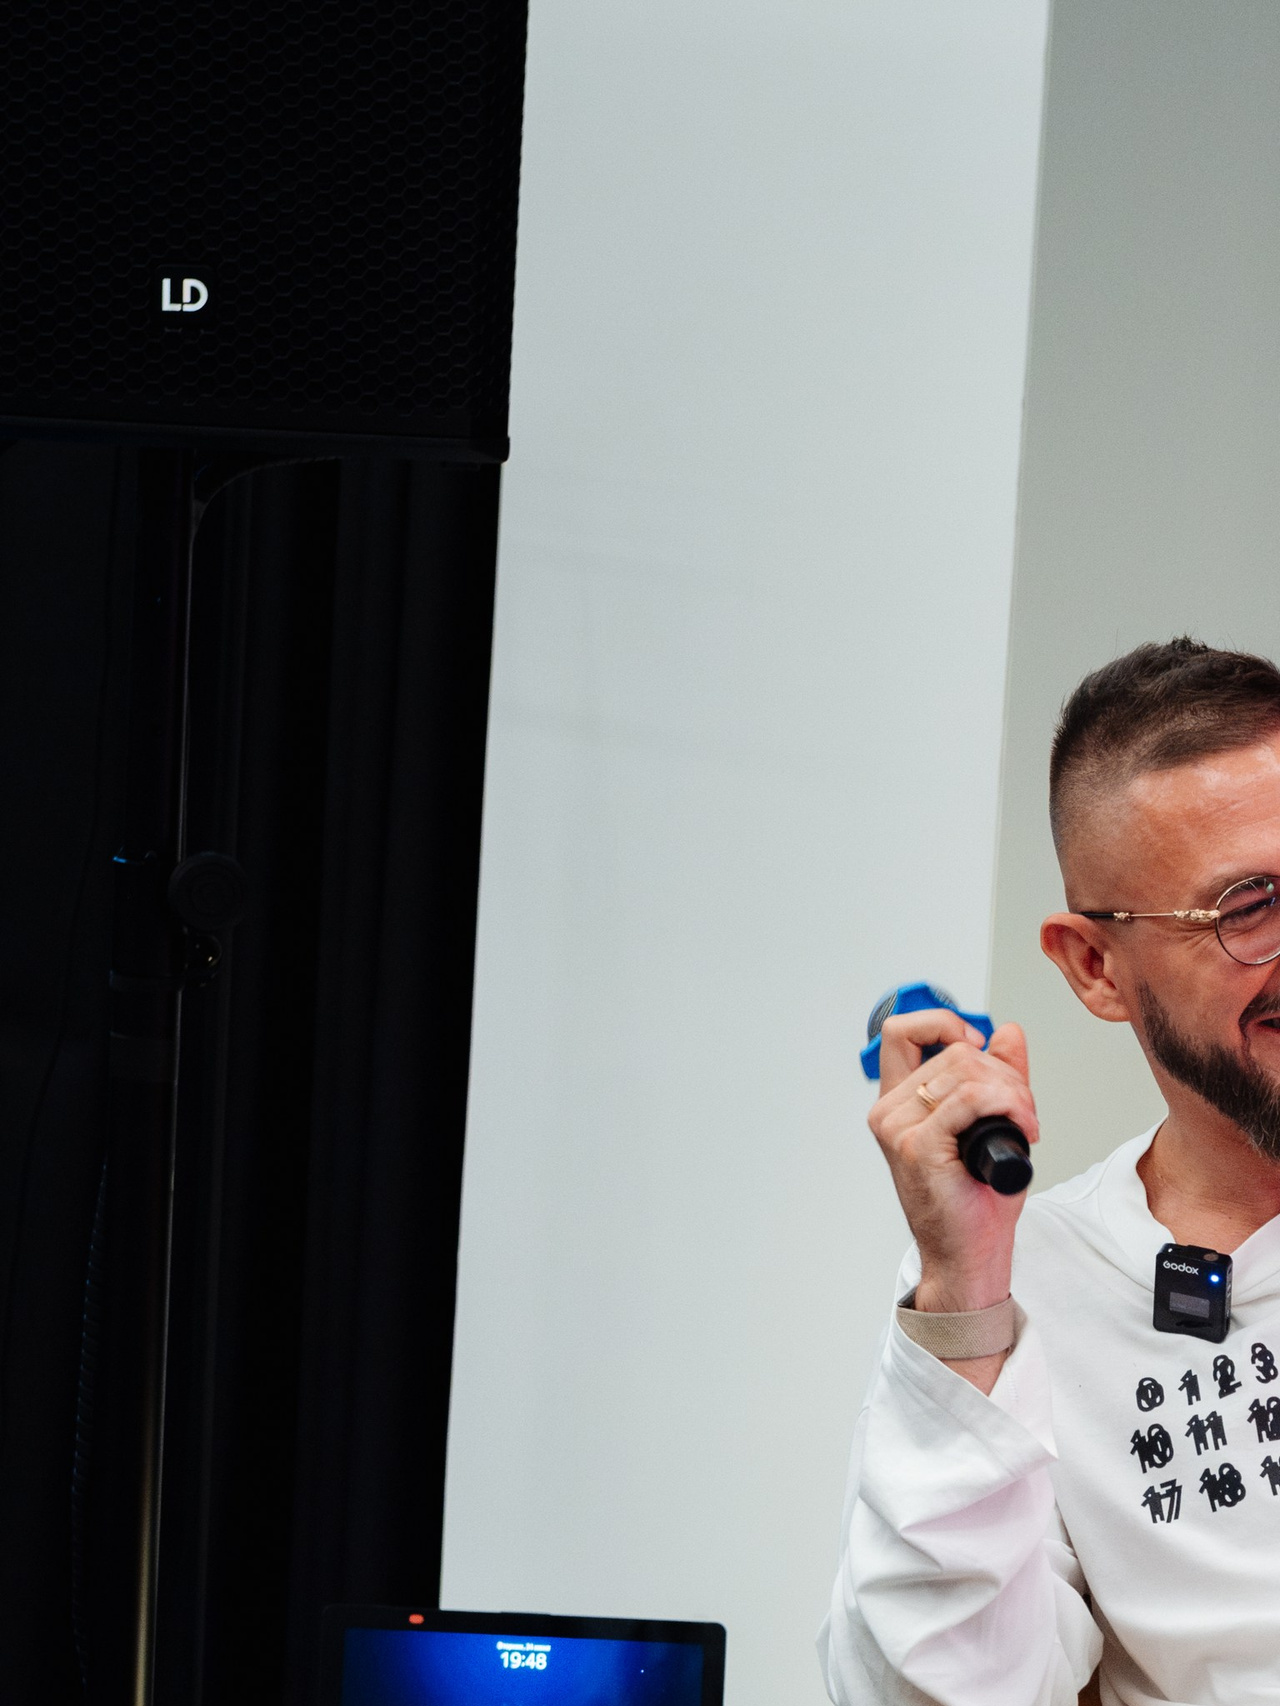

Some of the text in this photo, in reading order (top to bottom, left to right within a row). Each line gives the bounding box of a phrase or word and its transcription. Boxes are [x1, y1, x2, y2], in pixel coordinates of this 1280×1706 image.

[162, 278, 208, 312] LD
[1163, 1260, 1199, 1275] Godox
[1178, 1369, 1201, 1405] 1
[1213, 1355, 1242, 1399] 2
[1251, 1342, 1278, 1384] 3
[1130, 1423, 1174, 1474] 10
[1185, 1411, 1227, 1455] 11
[1141, 1479, 1182, 1523] 17
[1199, 1462, 1246, 1512] 18
[500, 1651, 547, 1670] 19:48
